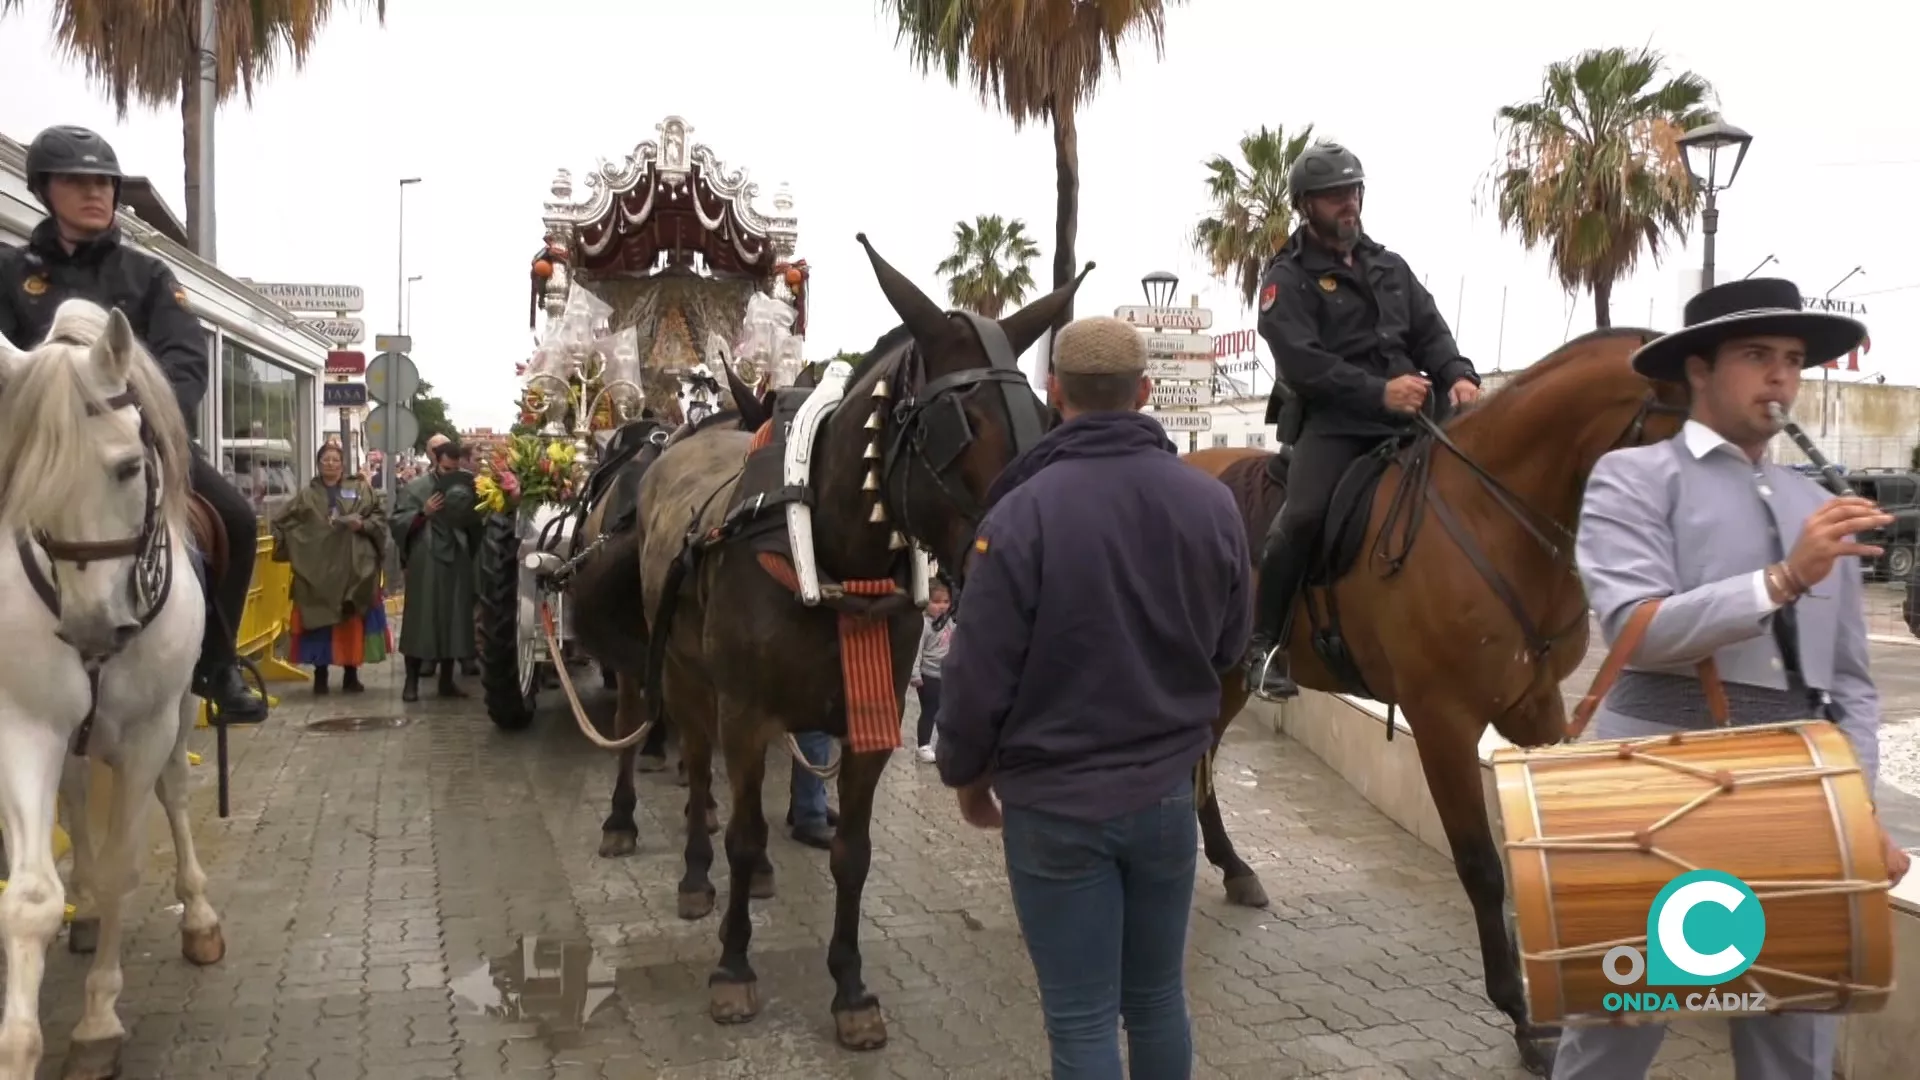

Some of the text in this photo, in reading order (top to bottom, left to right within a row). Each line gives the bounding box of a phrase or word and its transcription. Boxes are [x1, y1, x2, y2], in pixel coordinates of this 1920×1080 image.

[270, 285, 311, 297] GASPAR
[313, 286, 360, 298] FLORIDO
[1800, 296, 1867, 314] NZANILLA
[1146, 314, 1201, 328] LA GITANA
[1213, 328, 1256, 360] ampo
[1151, 386, 1198, 395] BODEGAS
[1176, 416, 1200, 426] FERRIS
